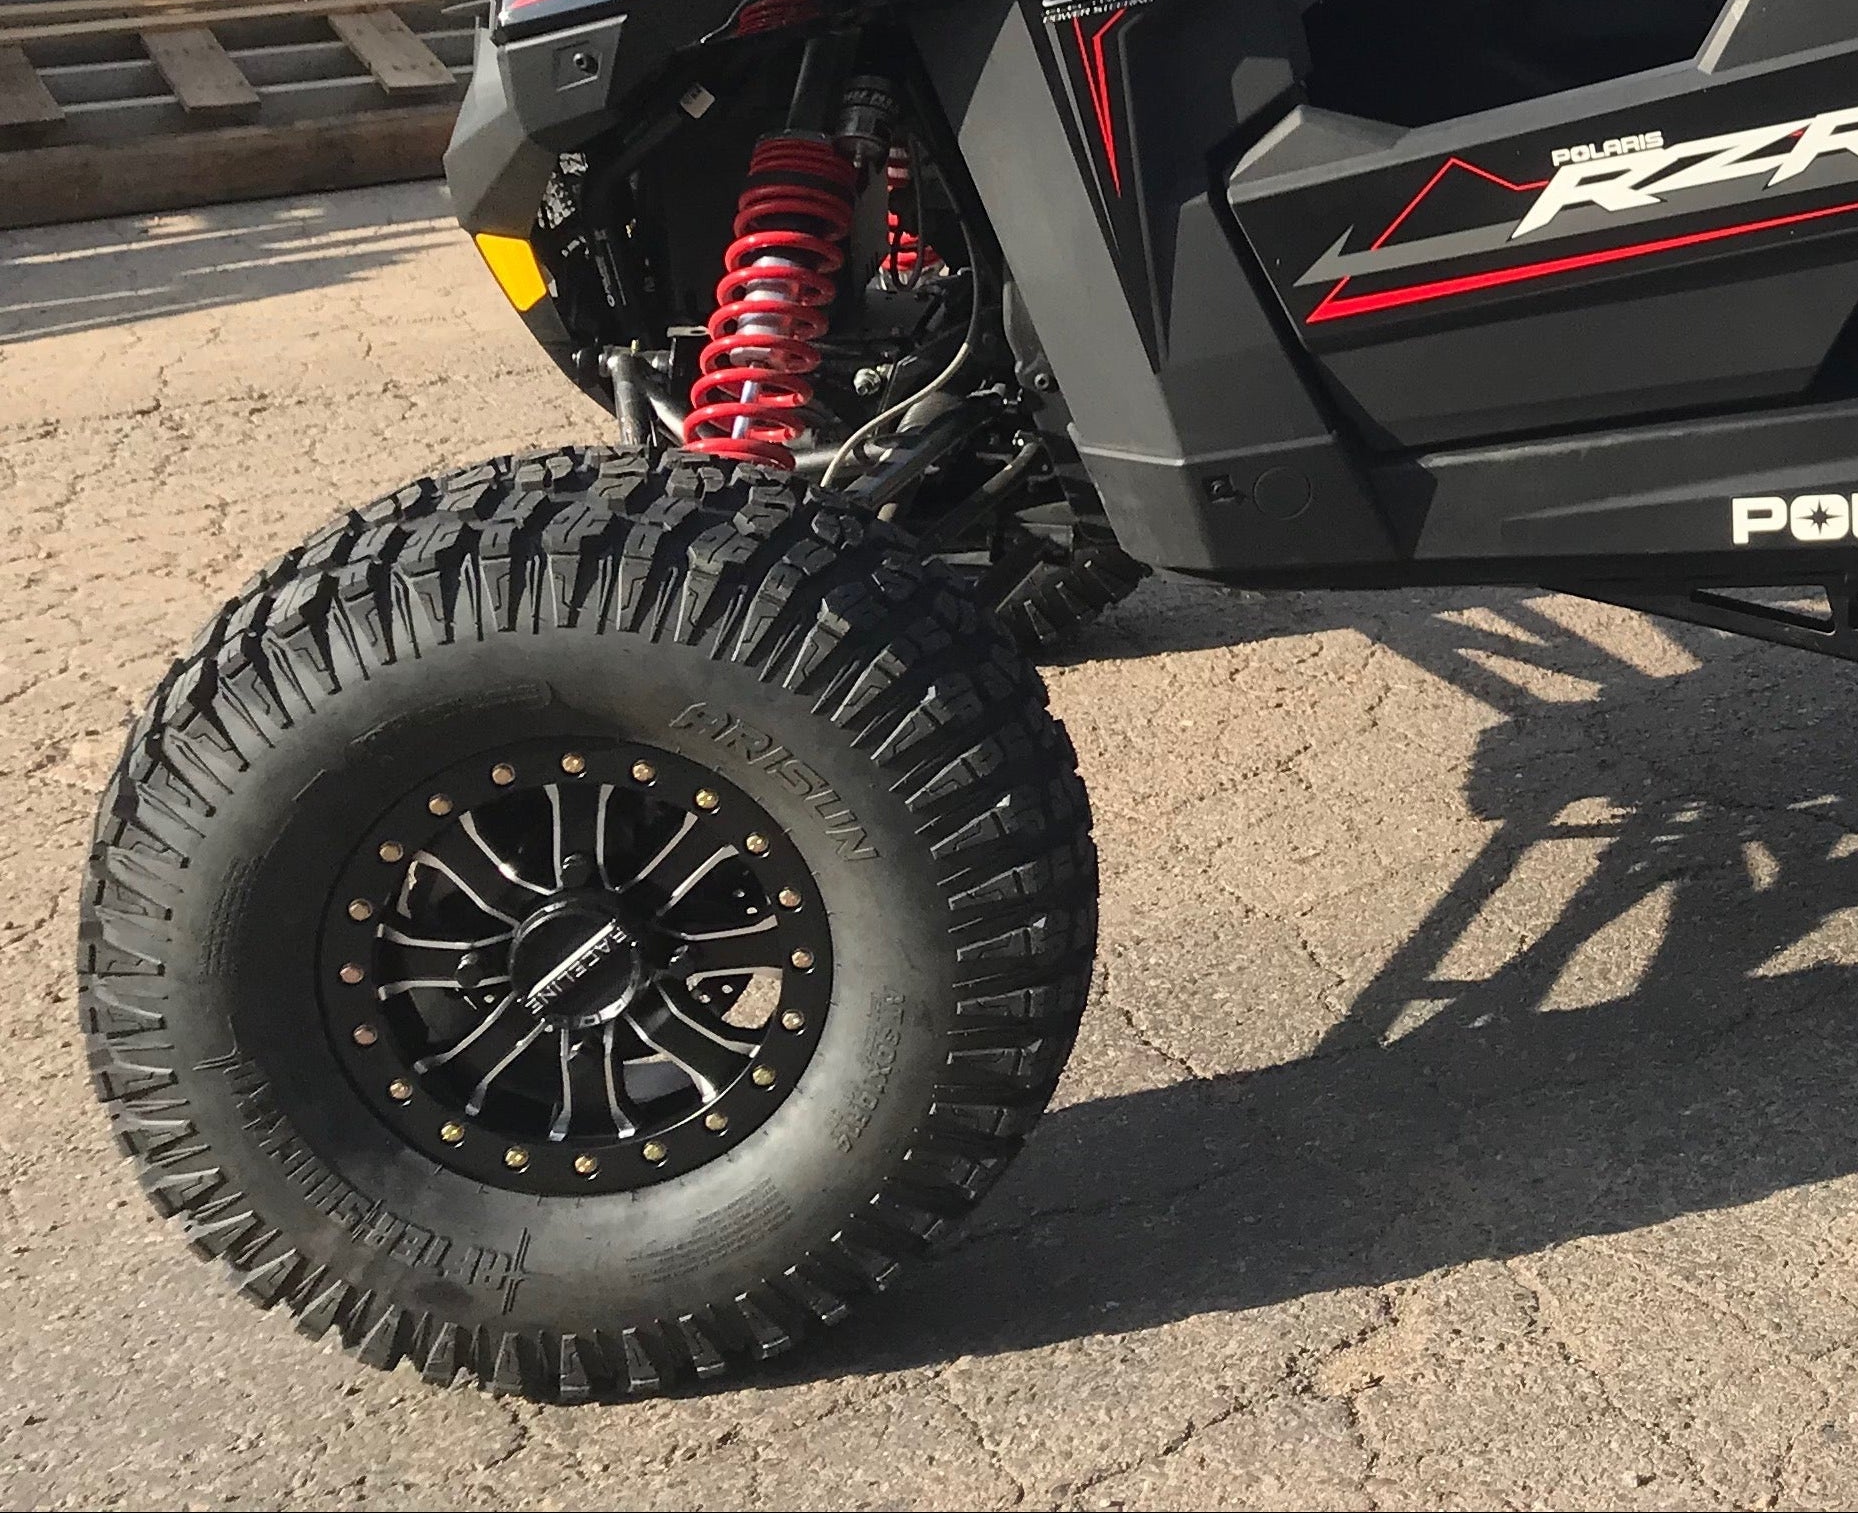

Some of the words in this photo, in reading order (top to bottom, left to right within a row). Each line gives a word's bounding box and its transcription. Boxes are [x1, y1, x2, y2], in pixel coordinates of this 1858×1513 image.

[1551, 131, 1664, 167] POLARIS
[669, 702, 881, 862] ARISUN
[525, 927, 627, 1014] RACELINE
